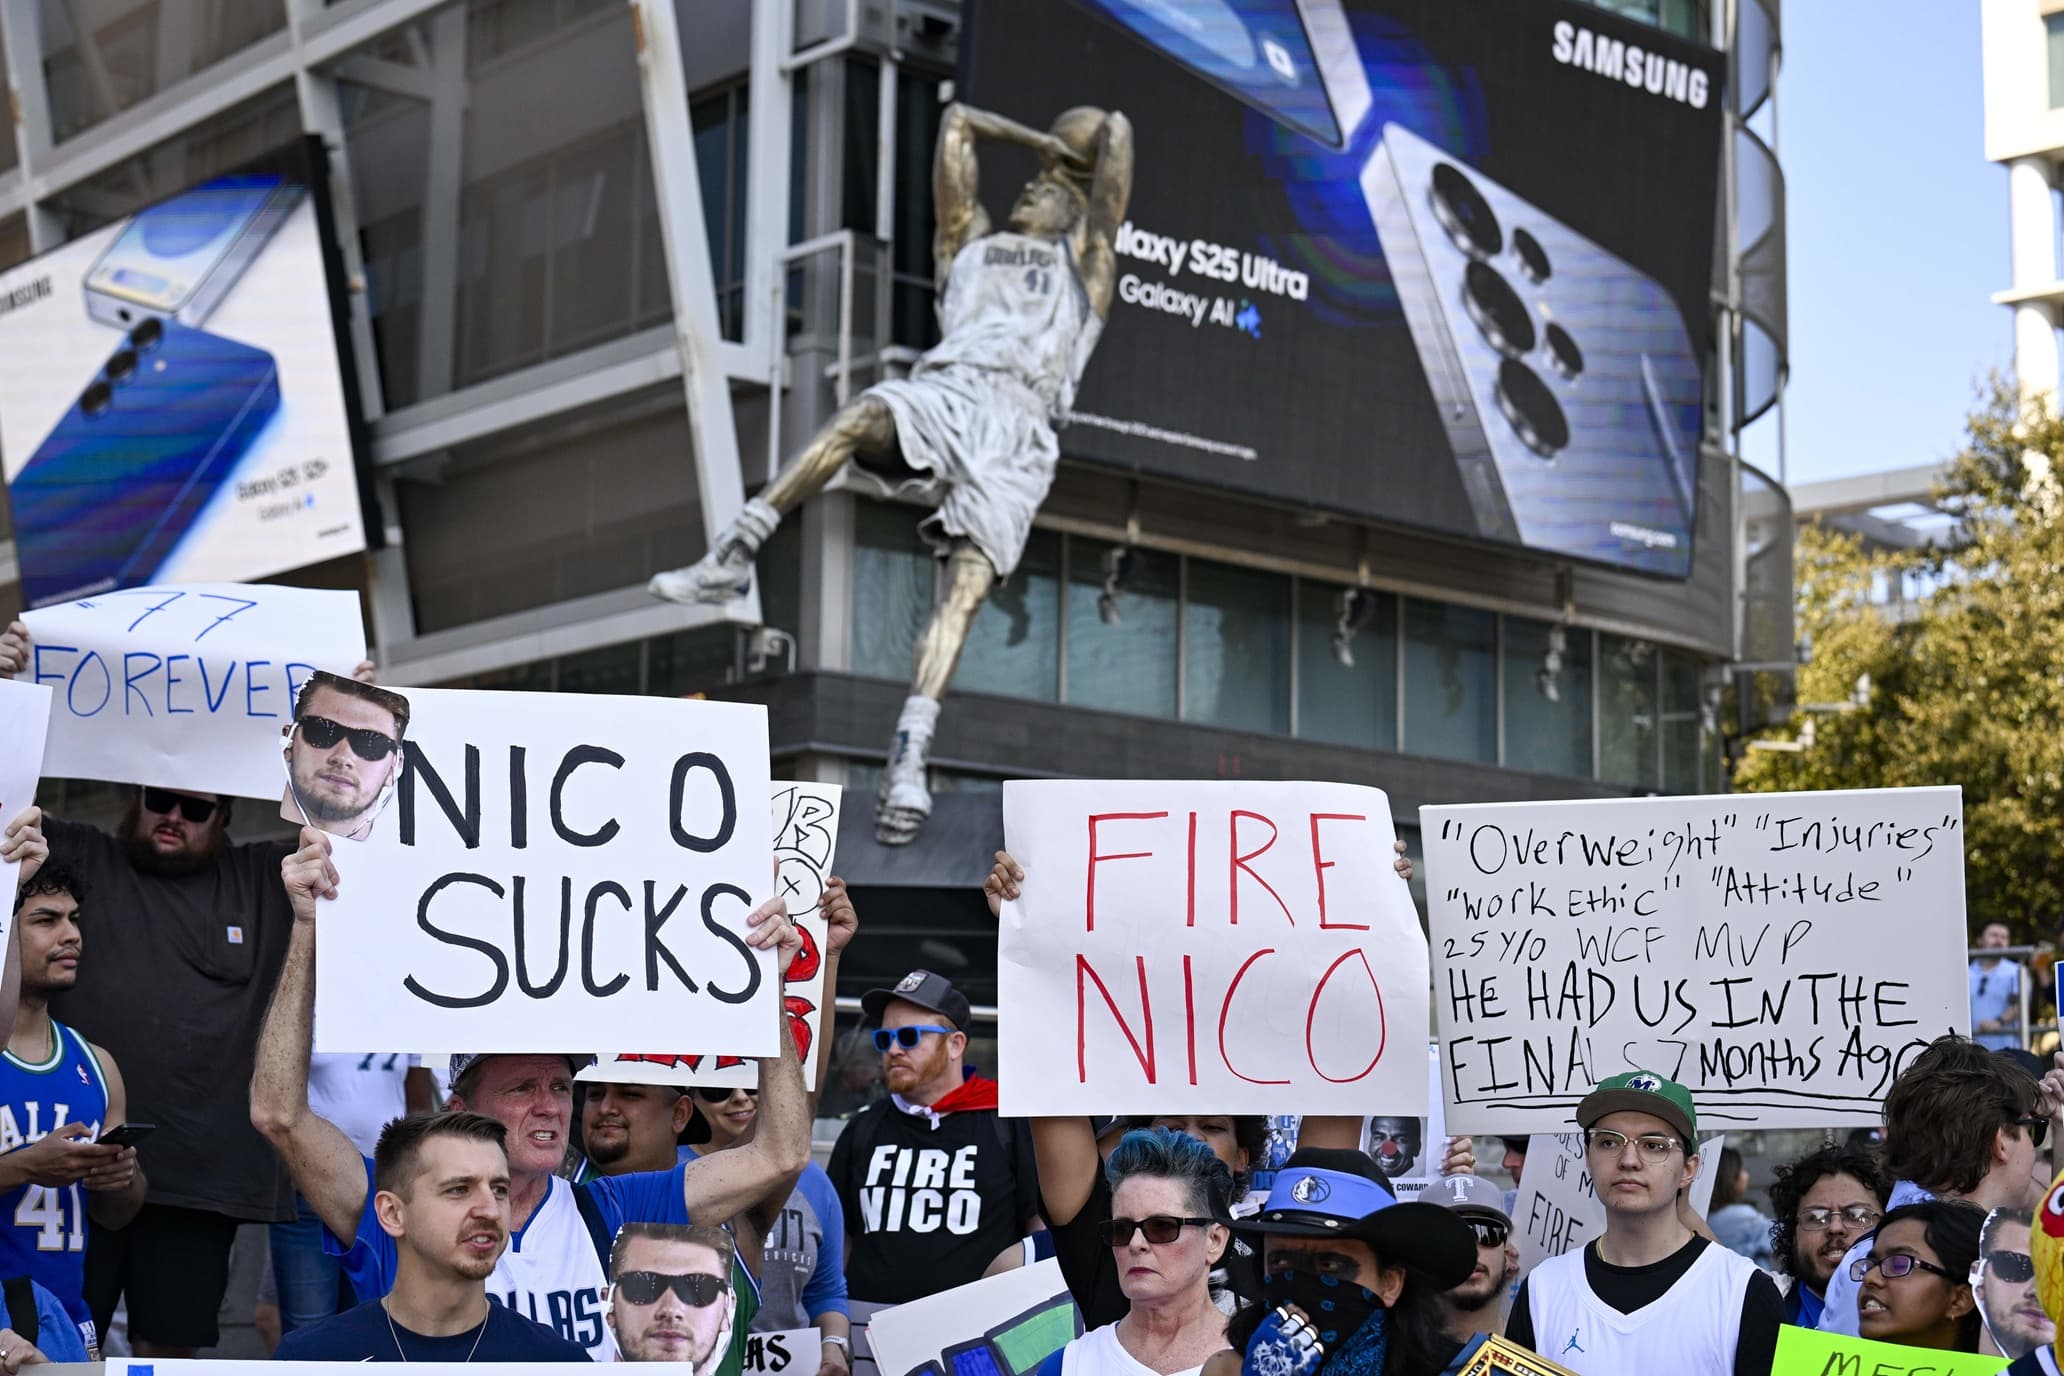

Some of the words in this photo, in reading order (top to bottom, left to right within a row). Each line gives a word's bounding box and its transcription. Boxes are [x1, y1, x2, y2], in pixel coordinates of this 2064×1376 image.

[1552, 20, 1709, 109] SAMSUNG
[1115, 220, 1188, 276] laxy
[1188, 239, 1240, 283] S25
[1241, 252, 1309, 301] Ultra
[1118, 273, 1209, 327] Galaxy
[1209, 297, 1235, 327] AI
[398, 739, 737, 853] NICO
[1755, 812, 1958, 862] "Injuries"
[1086, 809, 1371, 933] FIRE
[1711, 865, 1912, 907] "Attitude"
[403, 871, 763, 1009] SUCKS
[1576, 926, 1666, 967] WCF
[1695, 919, 1813, 967] MVP
[1076, 947, 1386, 1086] NICO
[1449, 967, 1508, 1024] HE
[1527, 960, 1616, 1029] HAD
[1633, 974, 1698, 1036] US
[1709, 977, 1792, 1029] IN
[1797, 972, 1919, 1031] THE
[1656, 1038, 1688, 1083] 7
[865, 1144, 978, 1189] FIRE
[1554, 1154, 1571, 1181] OF
[14, 1182, 85, 1252] 41
[859, 1187, 982, 1235] NICO
[763, 1251, 811, 1267] ERICKS
